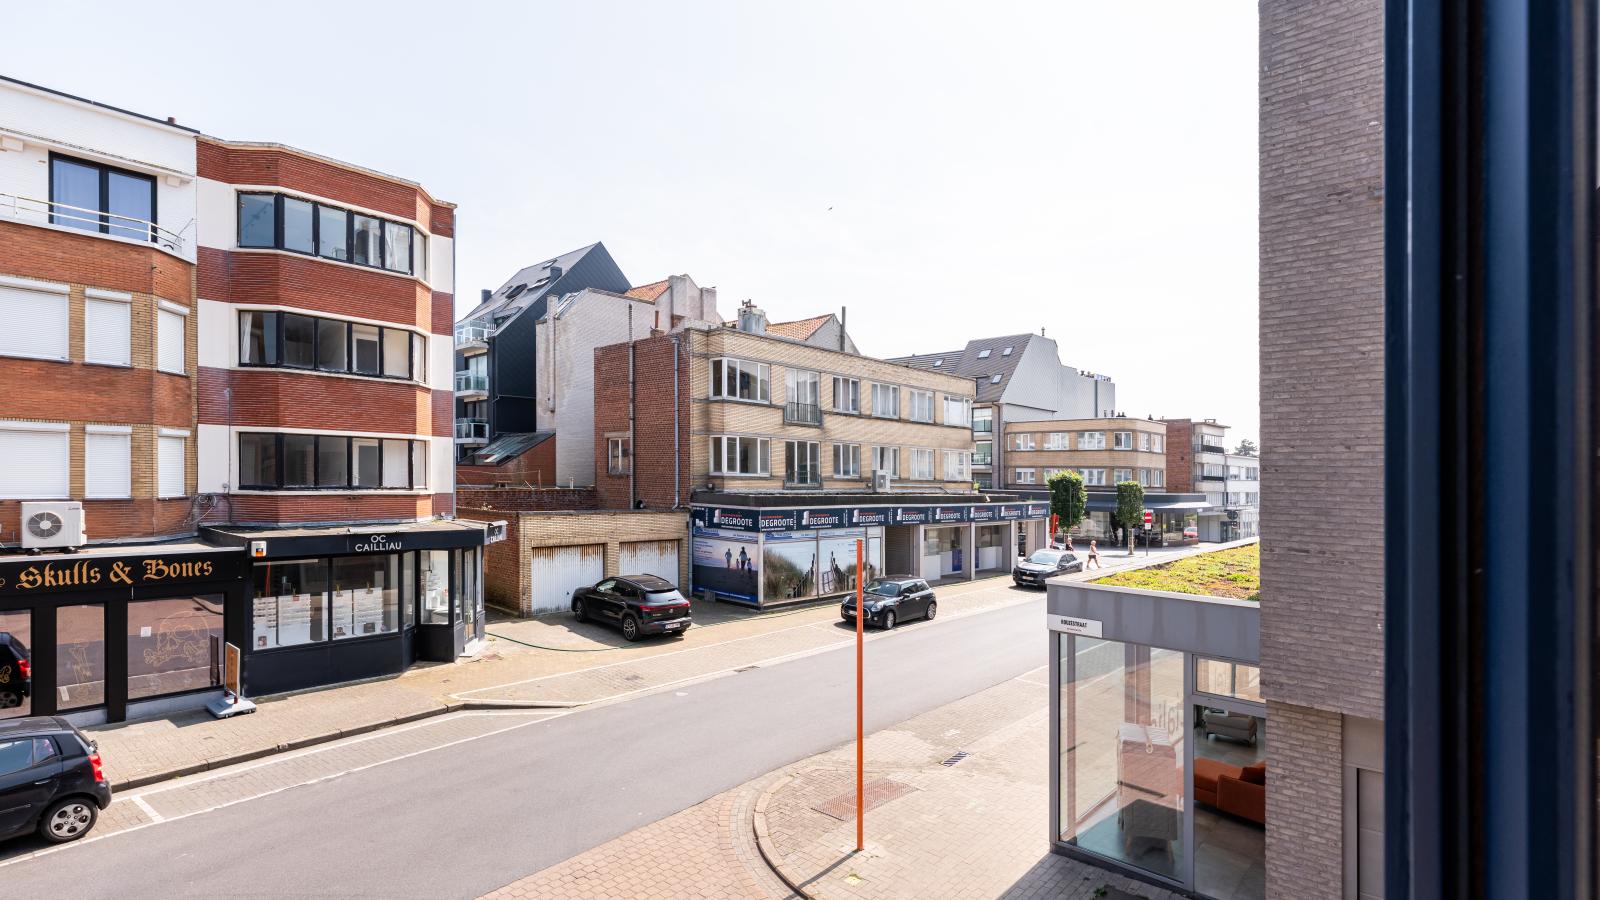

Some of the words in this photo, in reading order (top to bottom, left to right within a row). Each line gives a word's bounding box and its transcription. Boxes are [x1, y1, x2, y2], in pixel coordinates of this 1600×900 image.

[809, 517, 839, 525] DEGROOTE
[859, 514, 885, 522] DEGROOTE
[902, 513, 925, 521] DEGROOTE
[720, 517, 753, 527] DEGROOTE
[761, 518, 794, 528] DEGROOTE
[370, 534, 387, 543] OC
[355, 542, 402, 552] CAILLIAU
[15, 560, 101, 589] Skulls
[109, 561, 134, 585] &
[142, 559, 214, 580] Bones
